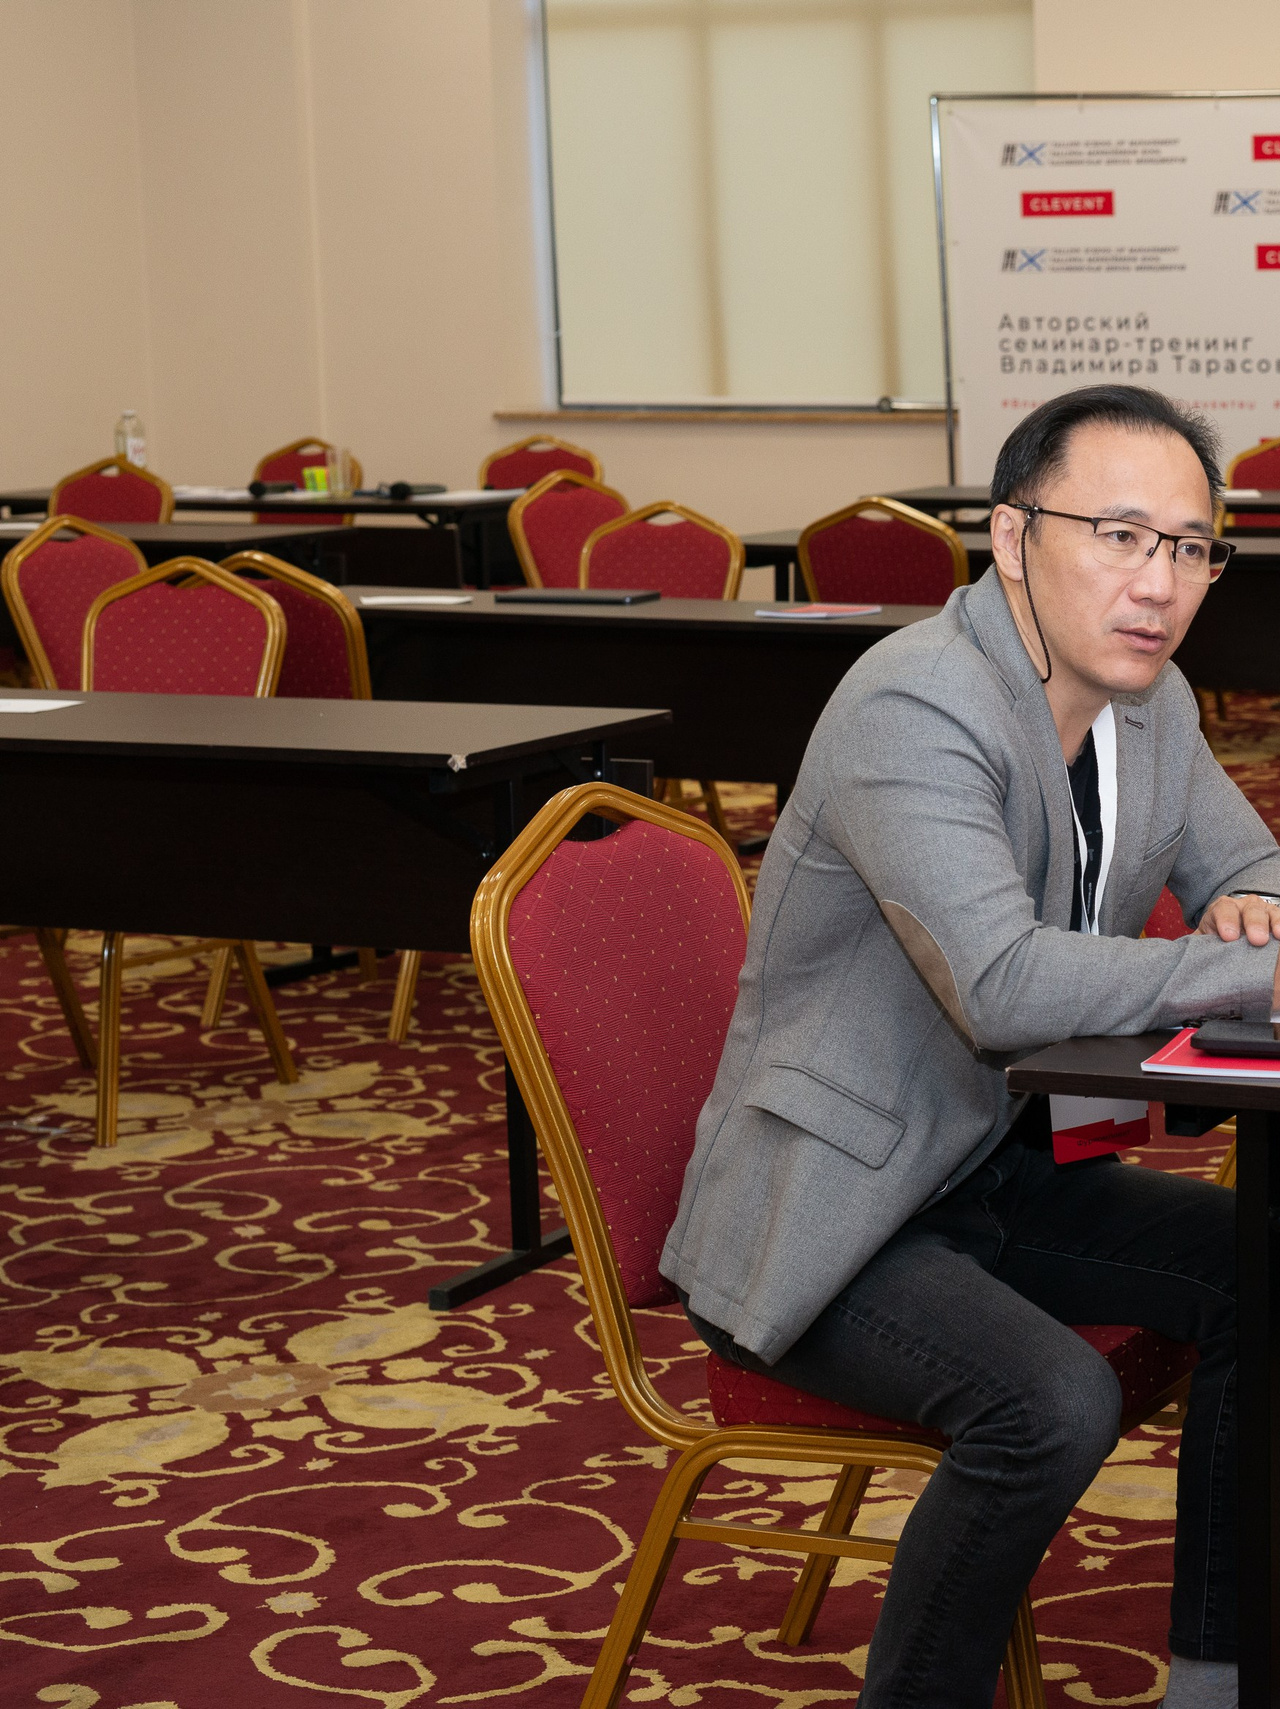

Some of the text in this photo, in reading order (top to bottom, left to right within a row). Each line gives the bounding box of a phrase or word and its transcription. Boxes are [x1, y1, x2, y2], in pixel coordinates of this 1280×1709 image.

[1029, 196, 1106, 212] CLEVENT
[998, 311, 1150, 334] Авторский
[998, 336, 1252, 356] семинар-тренинг
[1000, 354, 1159, 376] Владимира
